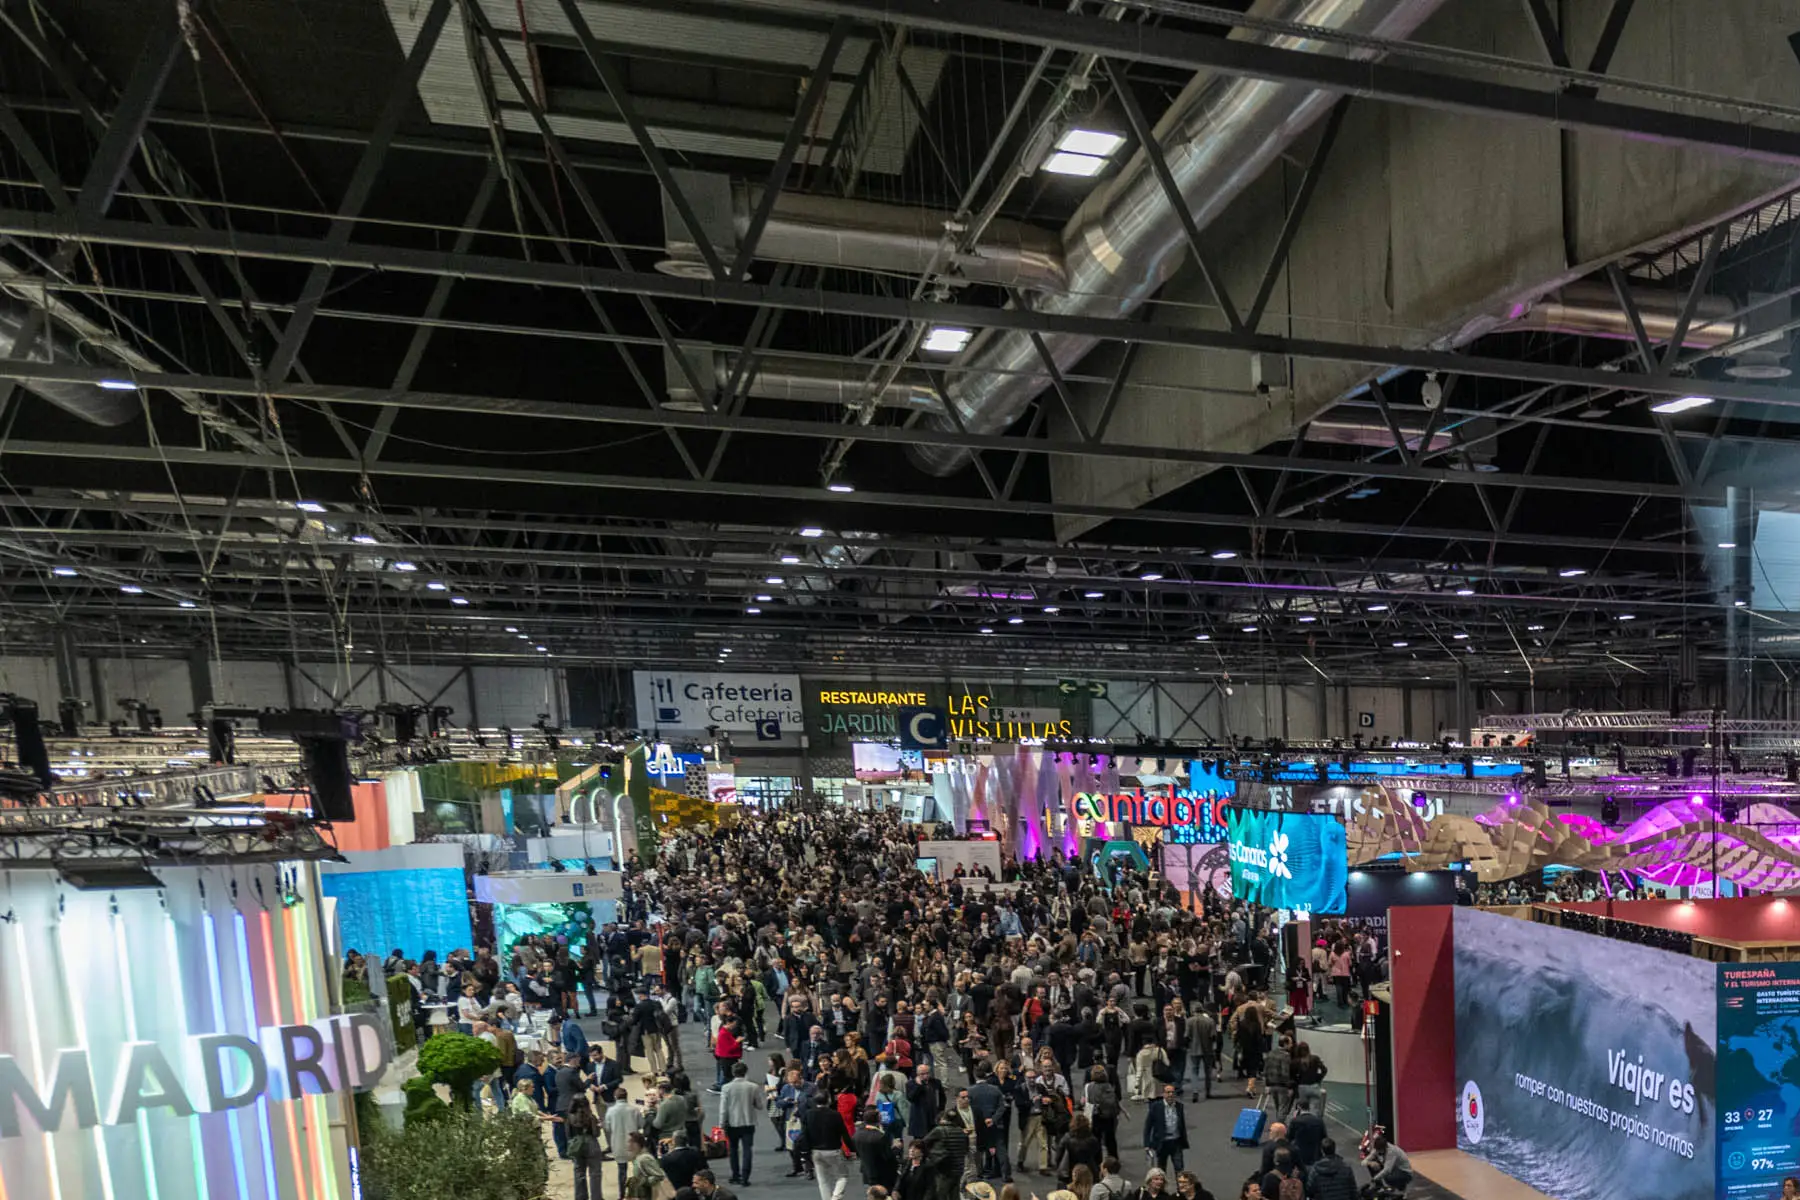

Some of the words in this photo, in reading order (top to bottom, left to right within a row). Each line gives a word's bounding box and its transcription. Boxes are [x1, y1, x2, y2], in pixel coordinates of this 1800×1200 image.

[683, 682, 793, 701] Cafetería
[820, 691, 927, 706] RESTAURANTE
[708, 704, 803, 724] Cafeteria
[948, 695, 990, 715] LAS
[761, 722, 777, 738] C
[820, 709, 896, 733] JARDÍN
[910, 712, 938, 745] C
[950, 719, 1072, 739] VISTILLAS
[1361, 716, 1372, 726] D
[1723, 968, 1776, 980] TURESPAÑA
[1741, 980, 1771, 988] TURISMO
[0, 1013, 391, 1138] MADRID
[1607, 1048, 1665, 1106] Viajar
[1668, 1078, 1695, 1115] es
[1515, 1071, 1546, 1098] romper
[1547, 1085, 1565, 1105] con
[1565, 1091, 1609, 1124] nuestras
[1610, 1110, 1650, 1141] propias
[1651, 1128, 1695, 1160] normas
[1724, 1111, 1741, 1124] 33
[1758, 1109, 1773, 1121] 27
[1751, 1158, 1775, 1171] 97%
